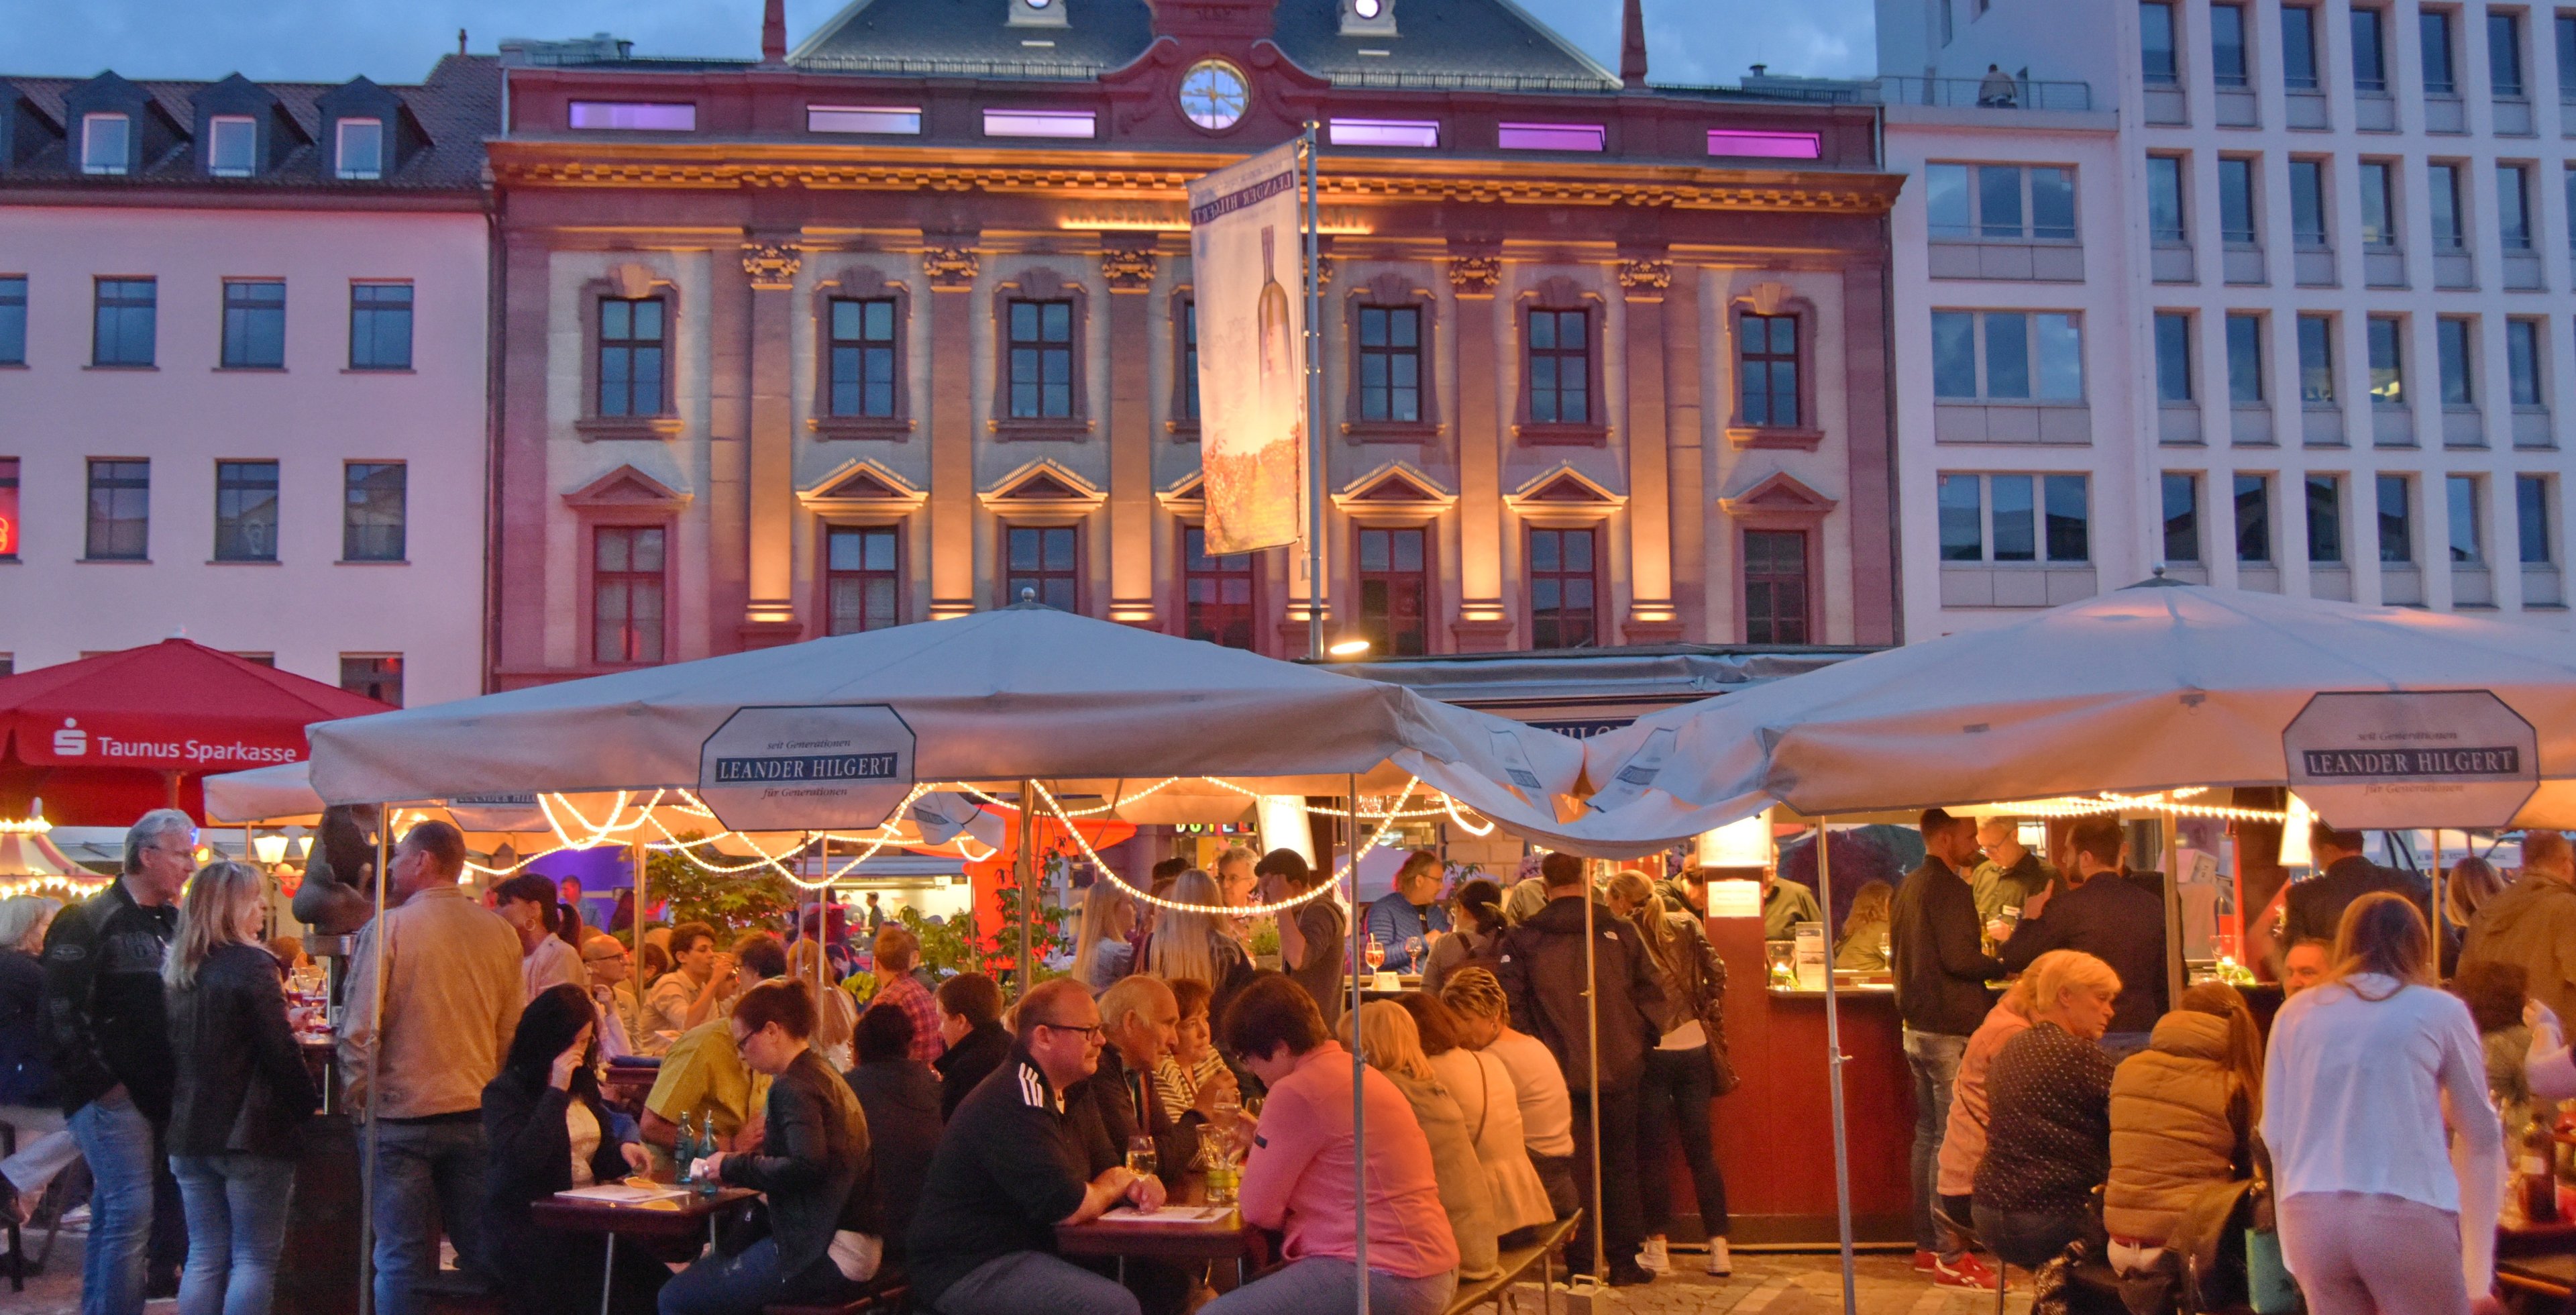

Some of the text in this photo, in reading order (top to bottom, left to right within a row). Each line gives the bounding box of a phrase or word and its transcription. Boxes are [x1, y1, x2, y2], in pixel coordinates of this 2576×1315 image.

[97, 736, 297, 763] Taunus Sparkasse
[767, 739, 851, 750] seit Generationen
[719, 756, 893, 780] LEANDER HILGERT
[2308, 749, 2514, 774] LEANDER HILGERT
[761, 786, 848, 800] für Generationen
